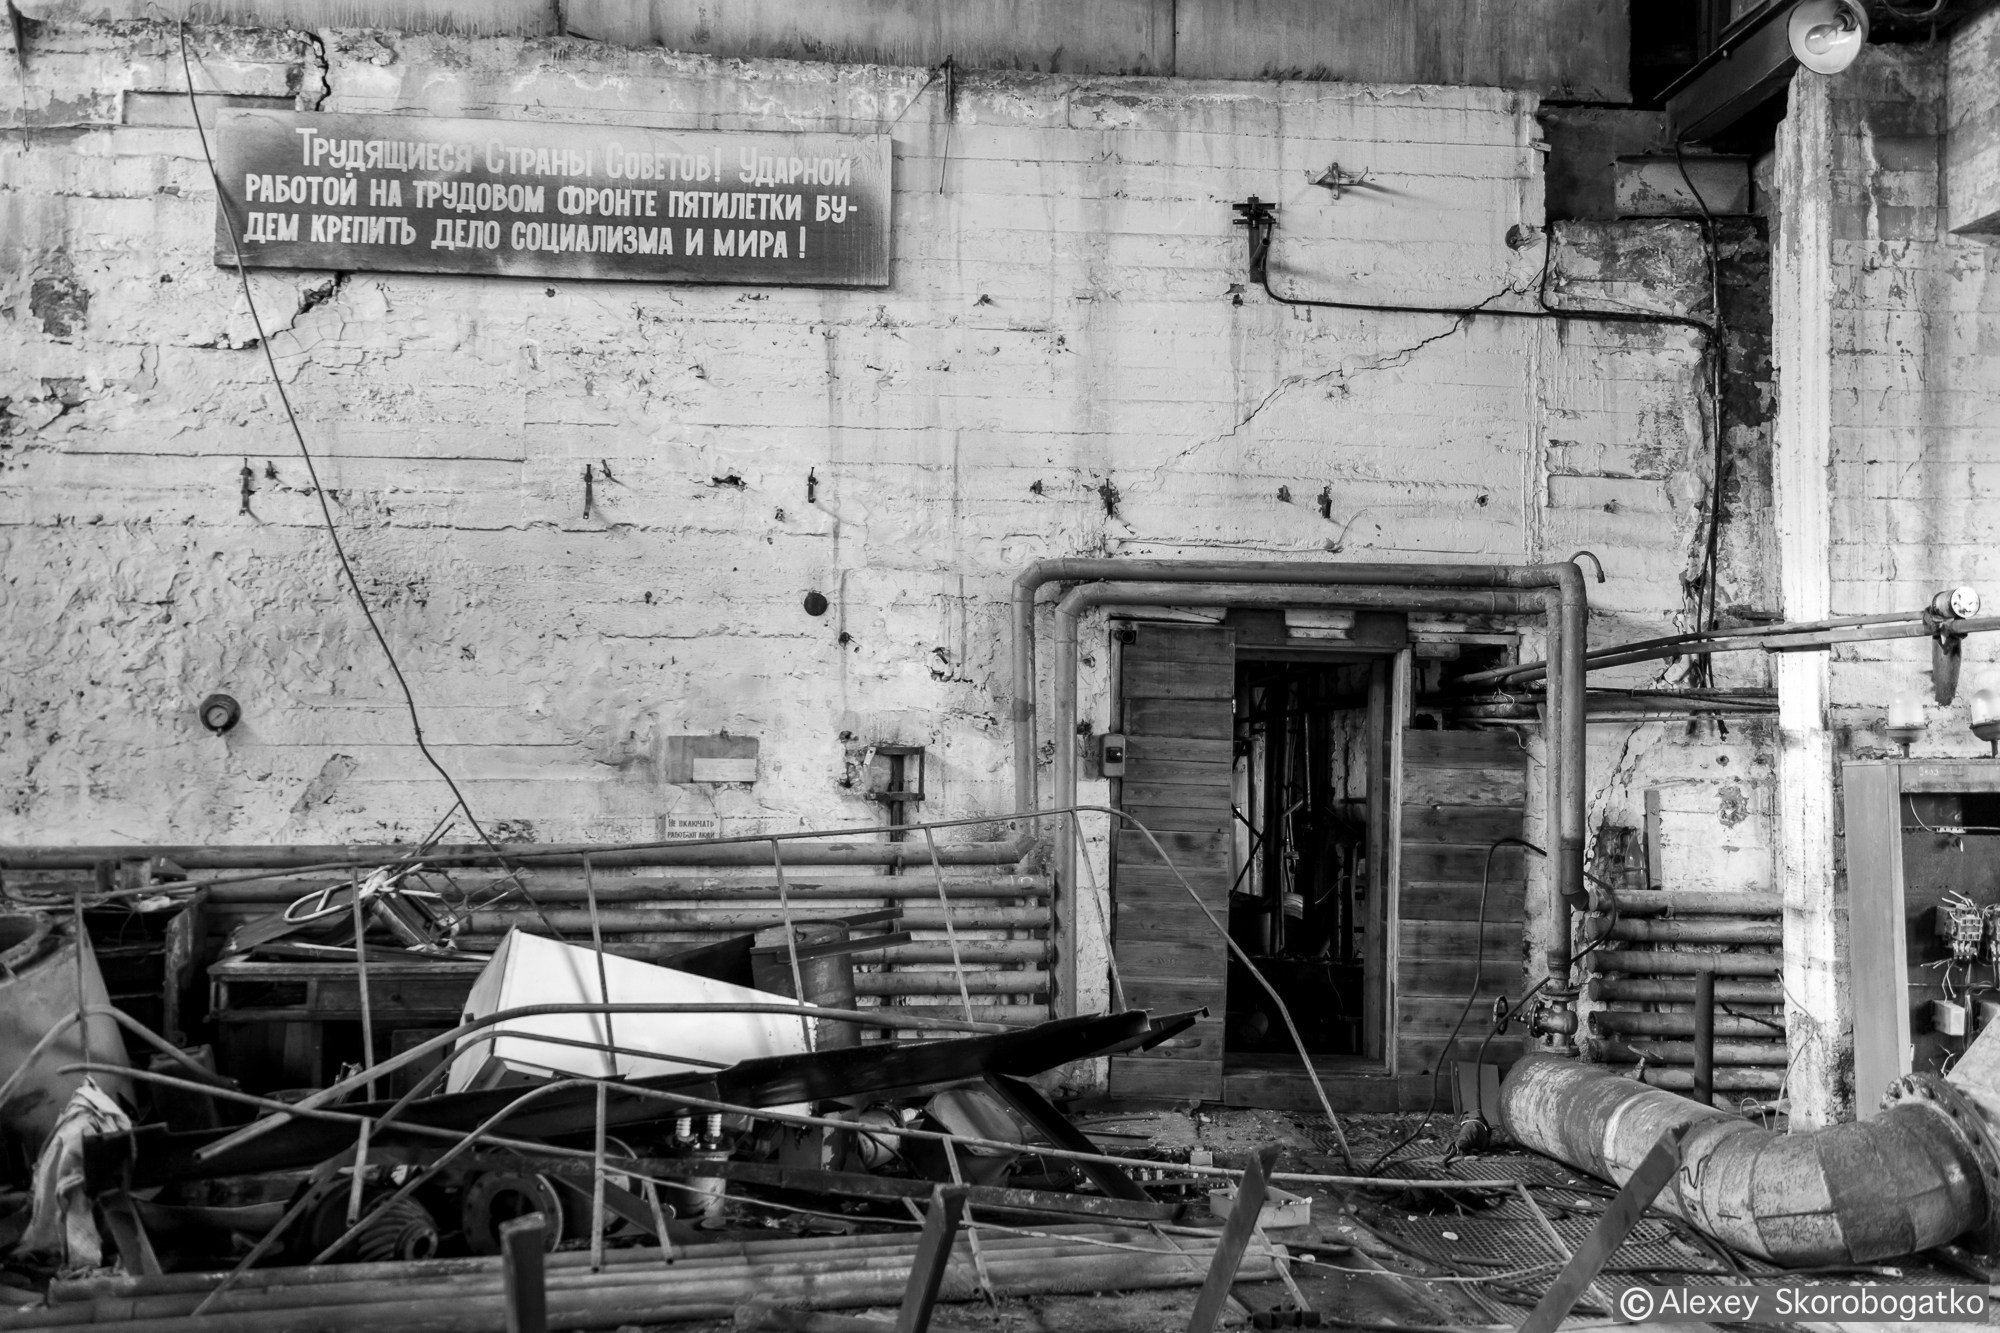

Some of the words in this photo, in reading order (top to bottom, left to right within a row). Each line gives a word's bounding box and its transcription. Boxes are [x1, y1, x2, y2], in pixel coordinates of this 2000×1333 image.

[245, 172, 358, 206] РАБОТОЙ
[370, 178, 403, 208] НА
[412, 180, 545, 214] ТРУДОВОМ
[557, 185, 657, 216] ФРОНТЕ
[668, 190, 802, 221] ПЯТИЛЕТКИ
[815, 194, 858, 224] БУ-
[243, 211, 300, 244] ДЕМ
[310, 214, 417, 246] КРЕПИТЬ
[430, 218, 500, 251] ДЕЛО
[511, 221, 673, 256] СОЦИАЛИЗМА
[685, 228, 704, 256] И
